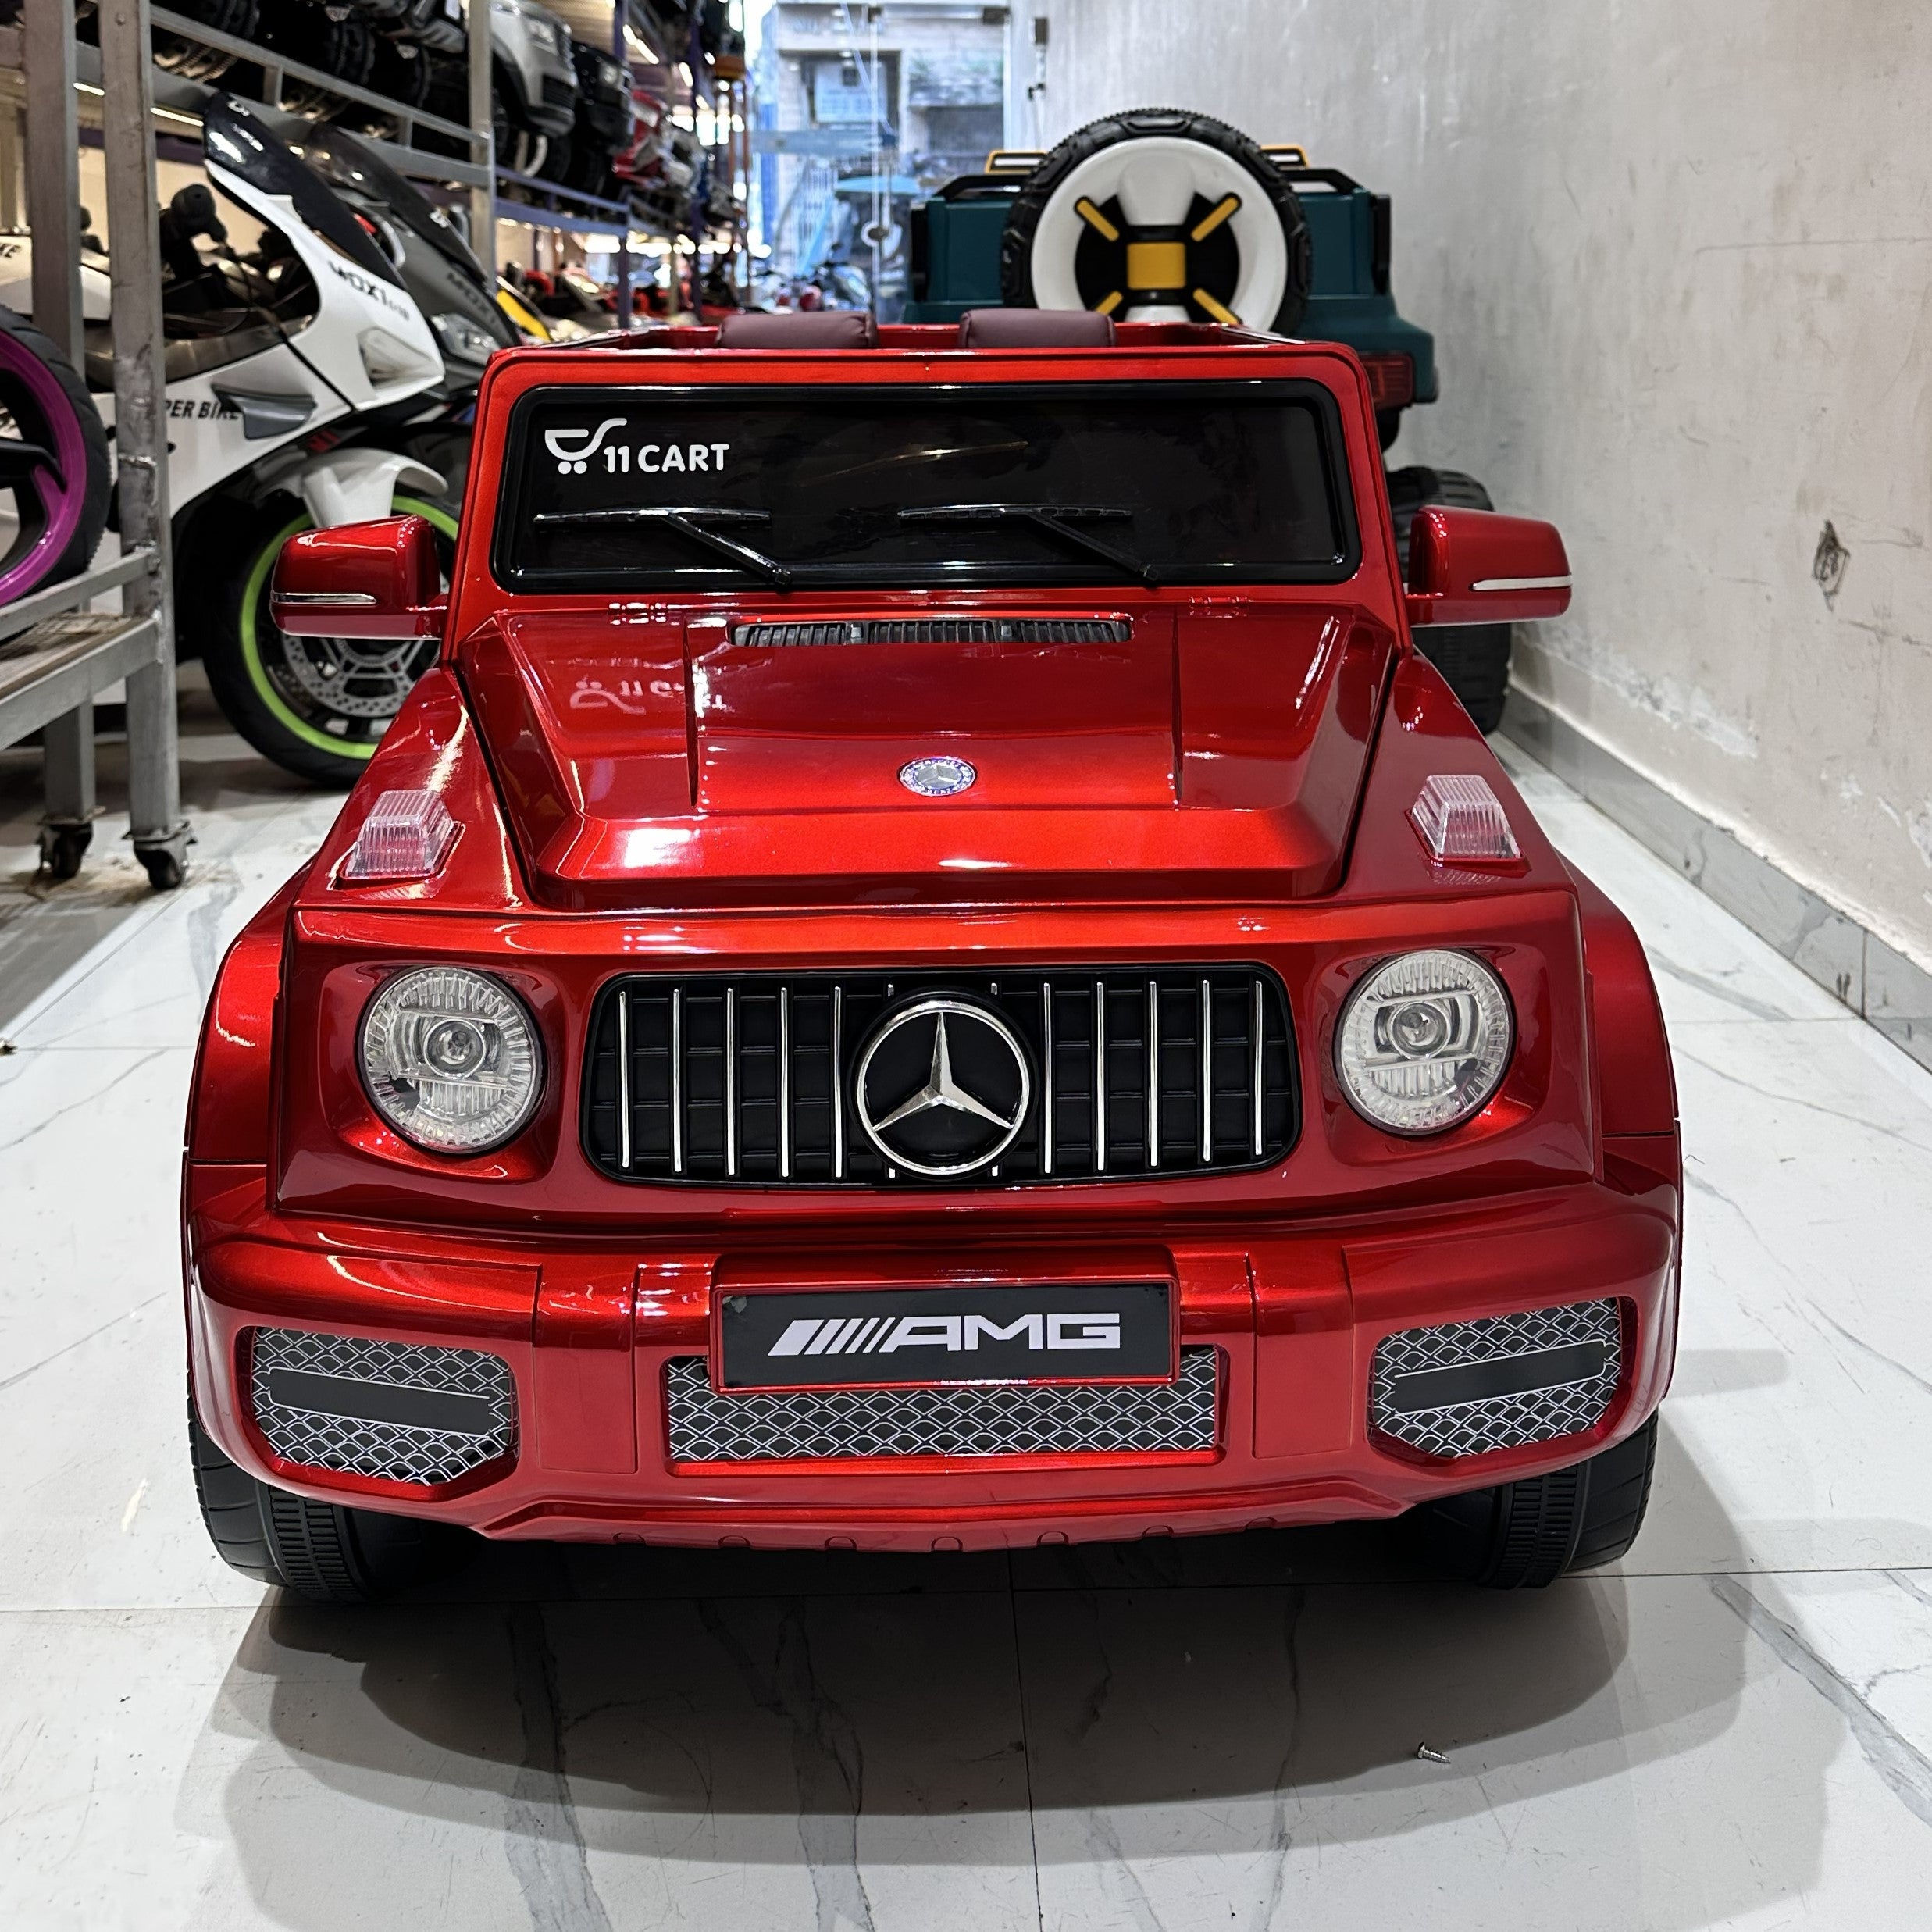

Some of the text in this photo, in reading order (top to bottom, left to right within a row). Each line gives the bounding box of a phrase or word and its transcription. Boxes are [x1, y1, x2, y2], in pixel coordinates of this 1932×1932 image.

[604, 444, 730, 473] 11 CART
[879, 1313, 1121, 1353] AMG
